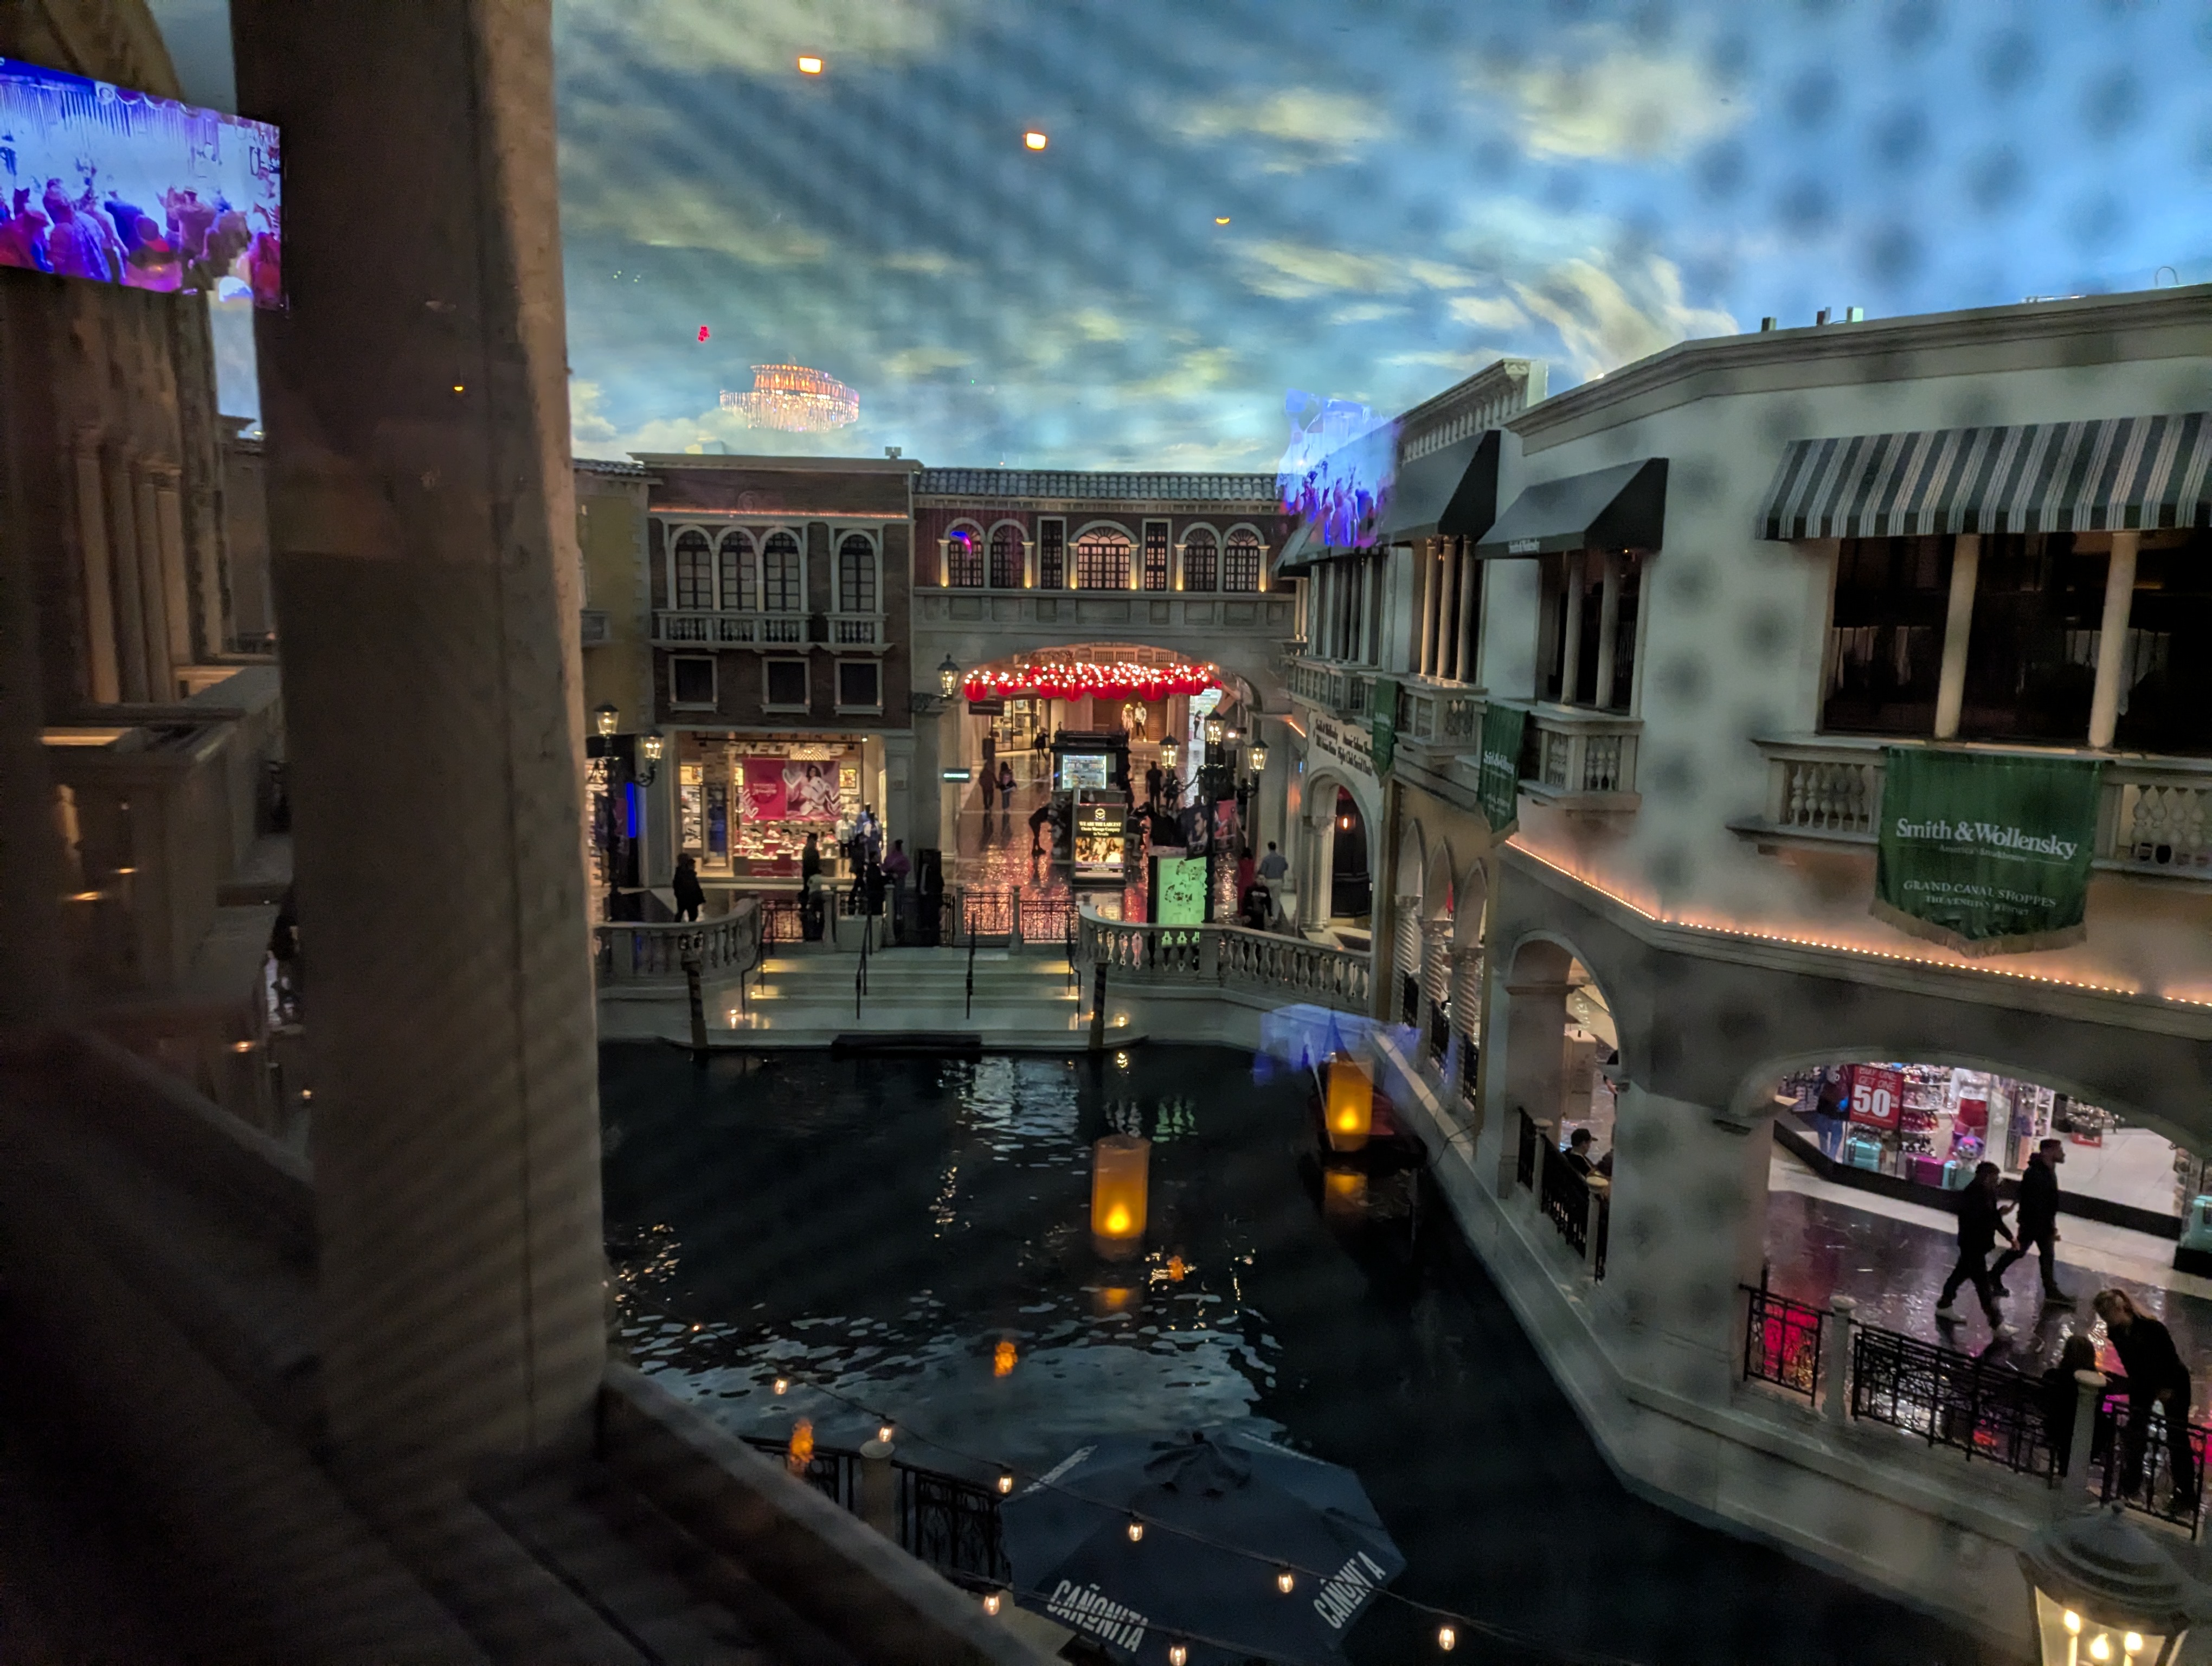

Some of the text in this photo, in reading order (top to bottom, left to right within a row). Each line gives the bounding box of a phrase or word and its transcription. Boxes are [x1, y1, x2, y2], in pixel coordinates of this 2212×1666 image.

[1896, 818, 2078, 860] Smith & Wollensky
[1904, 880, 2057, 908] GRAND CANAL SHOPPES
[1046, 1579, 1149, 1653] CAÑONITA
